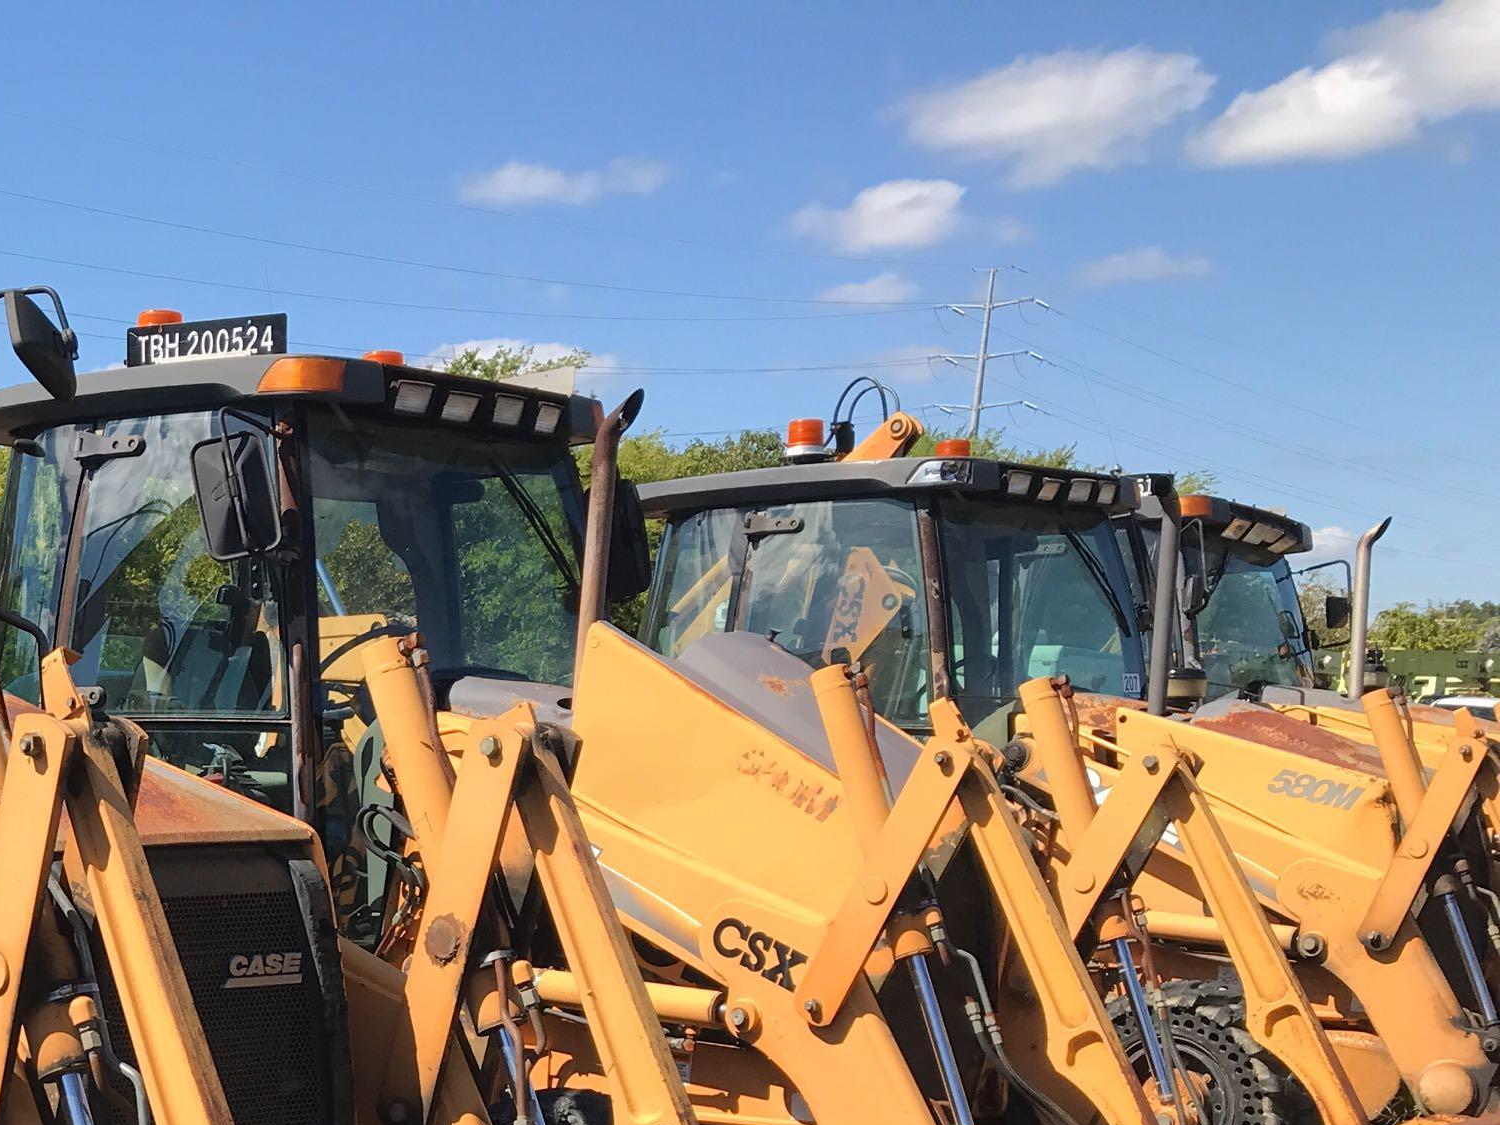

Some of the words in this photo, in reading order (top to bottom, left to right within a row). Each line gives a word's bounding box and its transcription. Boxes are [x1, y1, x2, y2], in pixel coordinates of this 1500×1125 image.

[138, 331, 180, 363] TBH
[187, 325, 274, 357] 200524
[833, 573, 866, 643] CSX
[1267, 768, 1366, 812] 580M
[229, 952, 302, 976] CASE
[713, 917, 809, 993] CSX
